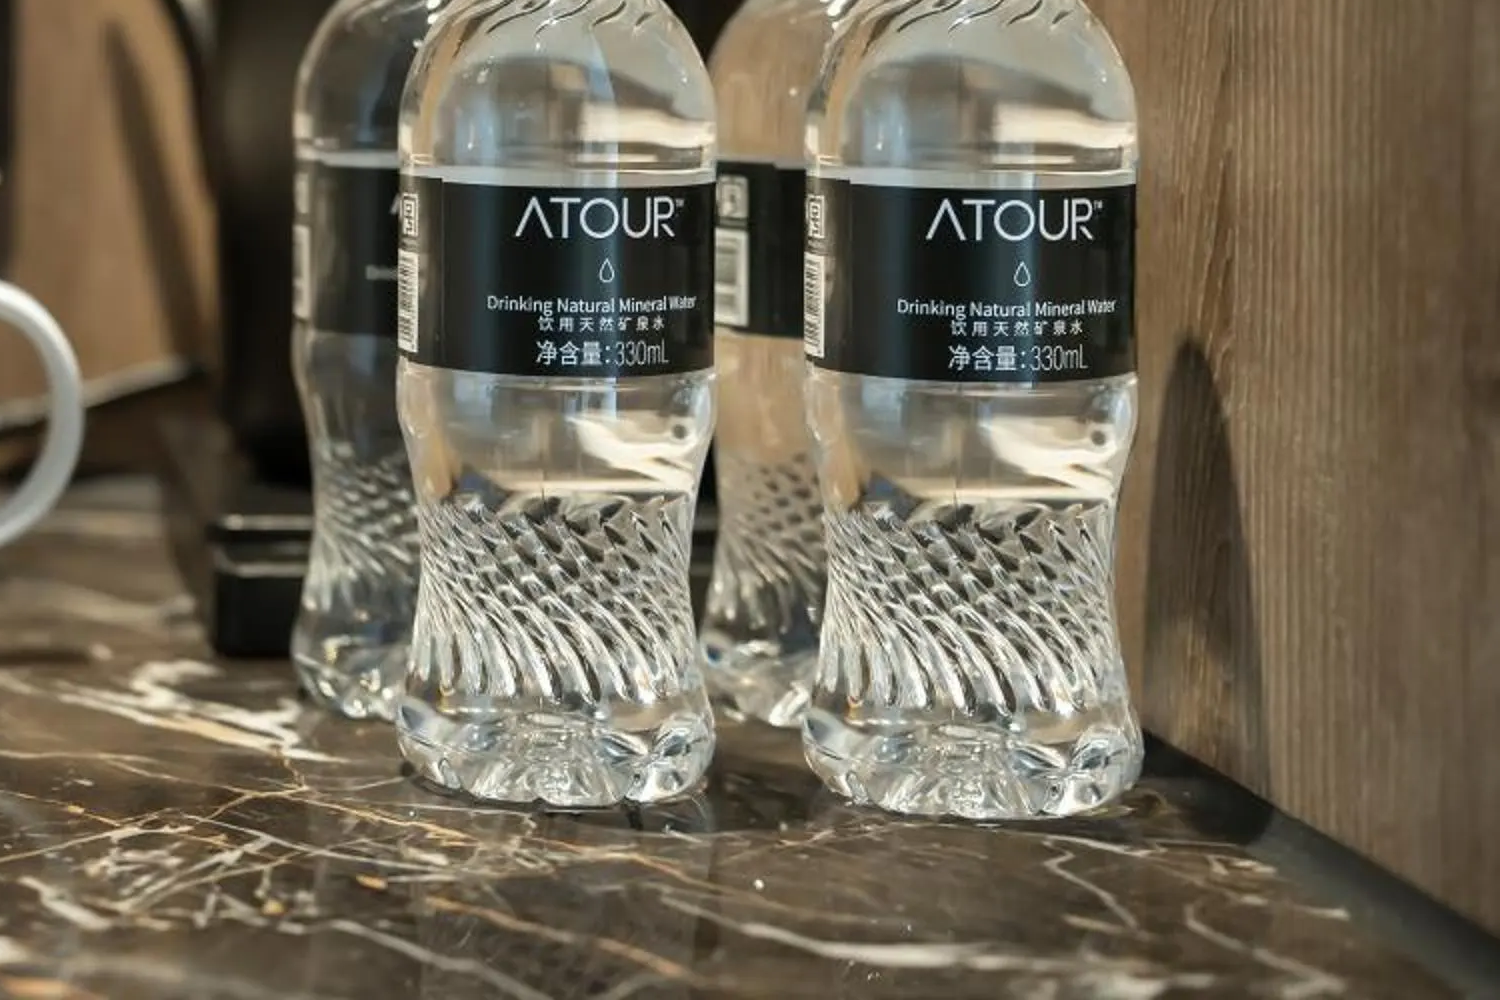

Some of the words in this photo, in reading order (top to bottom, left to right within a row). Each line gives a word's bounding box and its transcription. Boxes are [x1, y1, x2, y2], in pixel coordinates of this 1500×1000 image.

[514, 196, 677, 239] ATOUR
[924, 198, 1095, 241] ATOUR
[486, 295, 553, 317] Drinking
[556, 298, 616, 313] Natural
[618, 296, 667, 312] Mineral
[896, 298, 966, 320] Drinking
[969, 301, 1032, 317] Natural
[1034, 300, 1086, 317] Mineral
[1087, 299, 1117, 314] Water
[537, 315, 666, 332] 饮用天然矿泉水
[950, 320, 1084, 337] 饮用天然矿泉水
